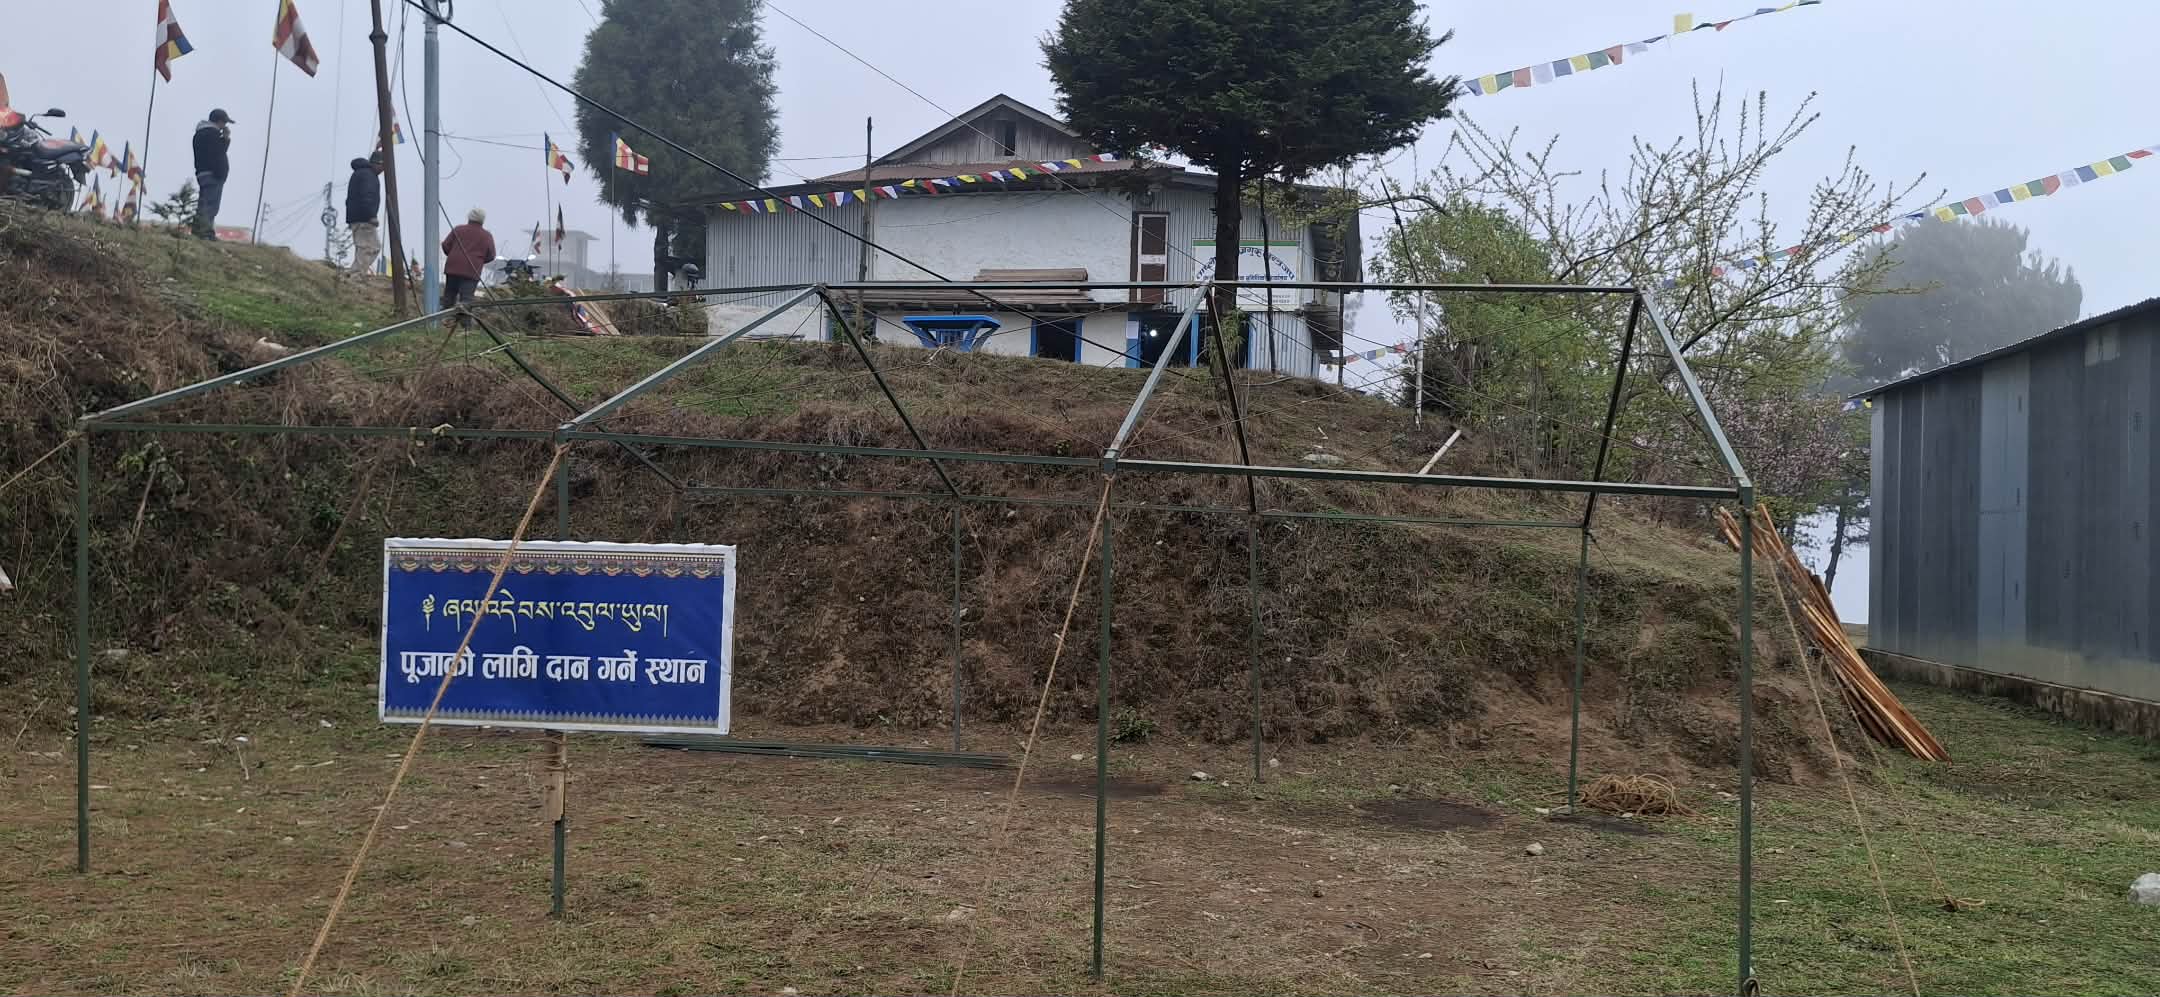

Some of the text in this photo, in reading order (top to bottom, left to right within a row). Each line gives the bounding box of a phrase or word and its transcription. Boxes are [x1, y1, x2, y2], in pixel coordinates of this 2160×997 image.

[400, 645, 708, 685] पूजाको लागि दान गर्ने स्थान
